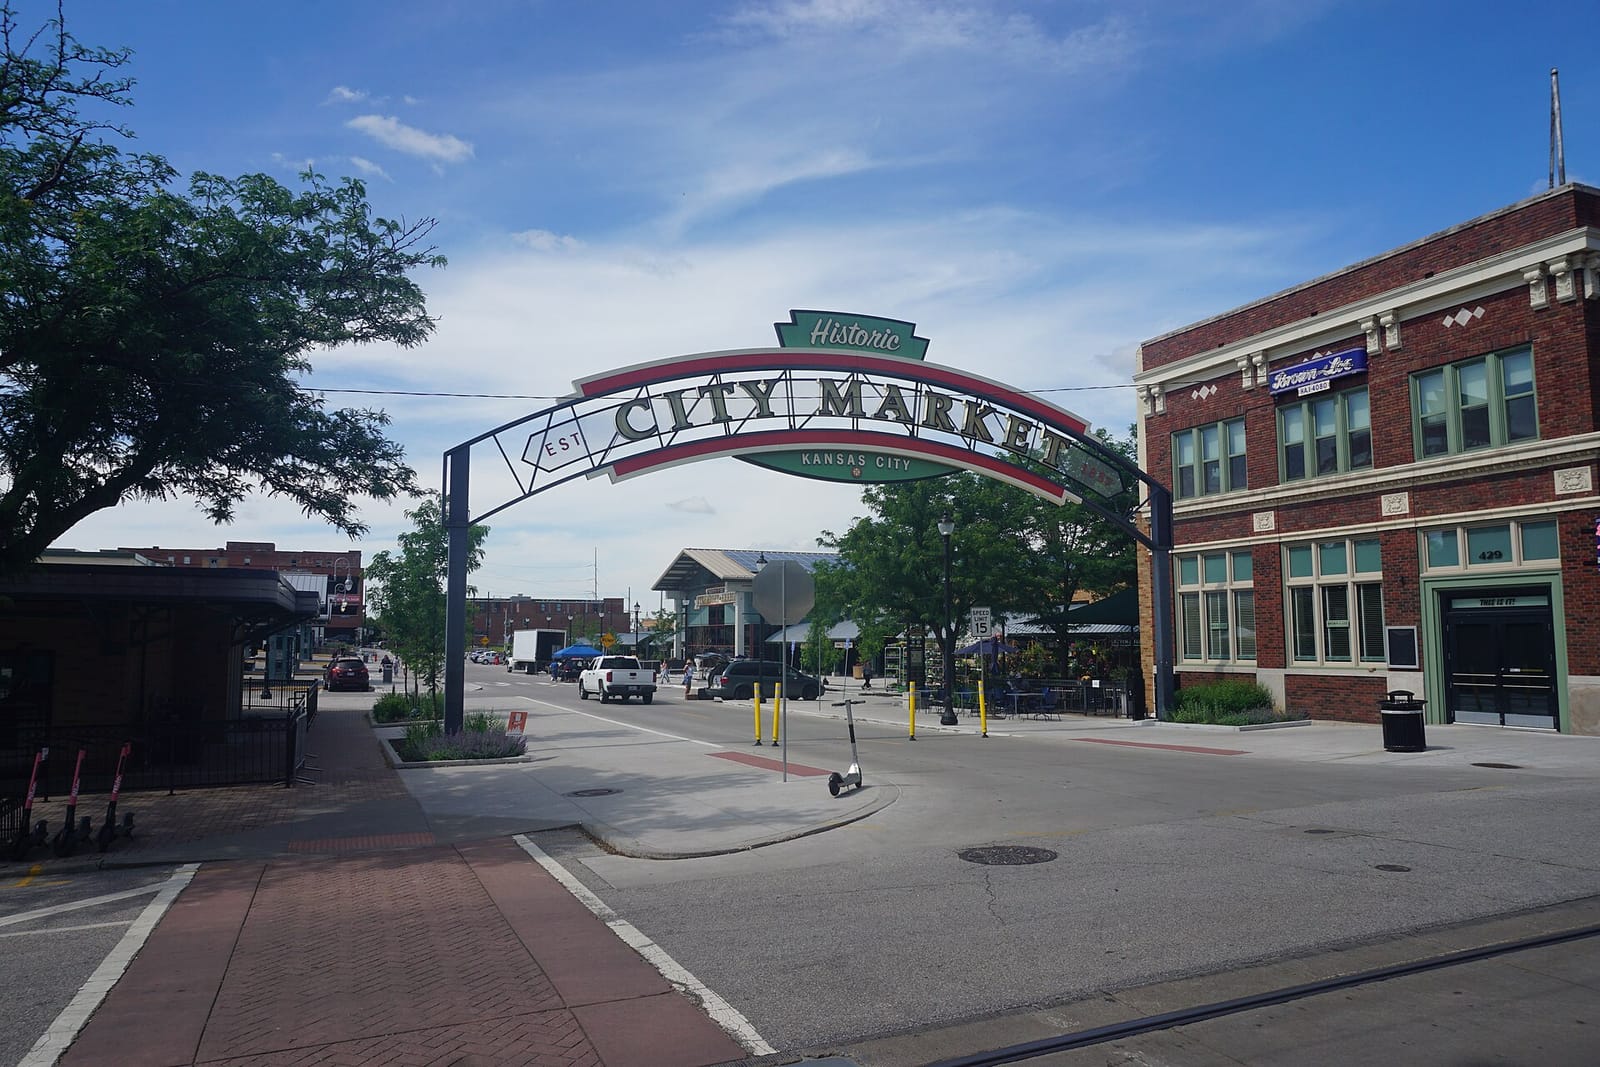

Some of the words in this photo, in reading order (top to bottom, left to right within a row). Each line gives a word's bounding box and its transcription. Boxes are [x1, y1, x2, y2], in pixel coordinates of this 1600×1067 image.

[810, 317, 901, 351] Historic
[614, 379, 779, 441] CITY
[816, 377, 1071, 470] MARKET
[544, 432, 580, 457] EST
[801, 452, 866, 467] KANSAS
[875, 456, 911, 471] CITY
[1478, 550, 1503, 560] 429
[976, 622, 987, 633] 15
